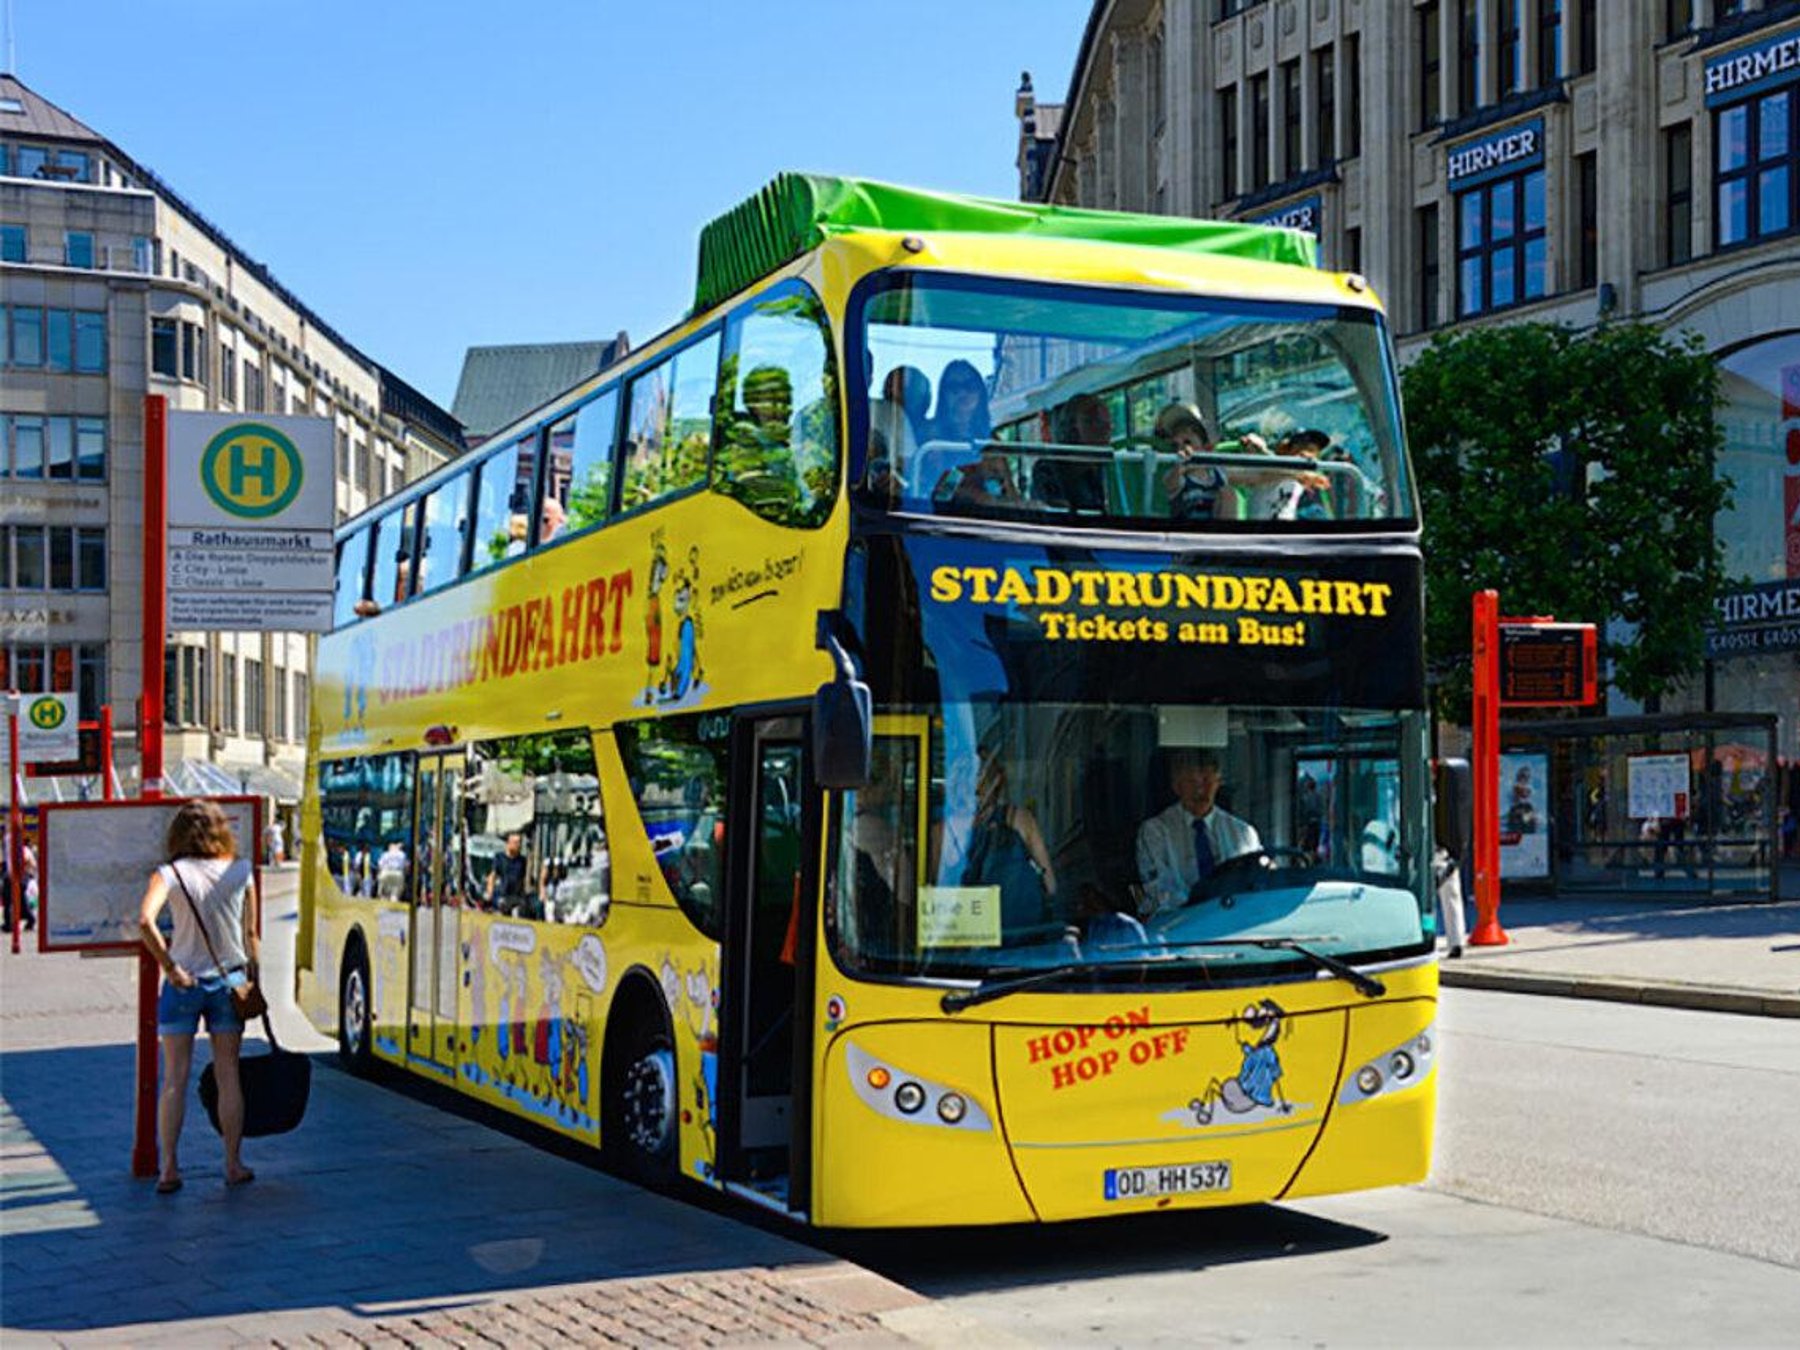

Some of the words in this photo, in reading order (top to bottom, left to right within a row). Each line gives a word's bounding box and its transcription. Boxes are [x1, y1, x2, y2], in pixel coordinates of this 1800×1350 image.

[1704, 37, 1800, 94] HIRME
[1447, 129, 1535, 179] HIRMER
[229, 445, 275, 496] H
[192, 532, 312, 548] Rathausmarkt
[930, 565, 1392, 617] STADTRUNDFAHRT
[1040, 613, 1168, 642] Tickets
[1179, 621, 1229, 643] am
[1238, 616, 1305, 646] Bus!
[1026, 1023, 1096, 1064] HOP
[1103, 1006, 1150, 1040] ON
[1051, 1048, 1119, 1090] HOP
[1129, 1026, 1190, 1065] OFF
[1118, 1171, 1145, 1195] OD
[1158, 1167, 1187, 1191] HH
[1190, 1161, 1229, 1189] 537
